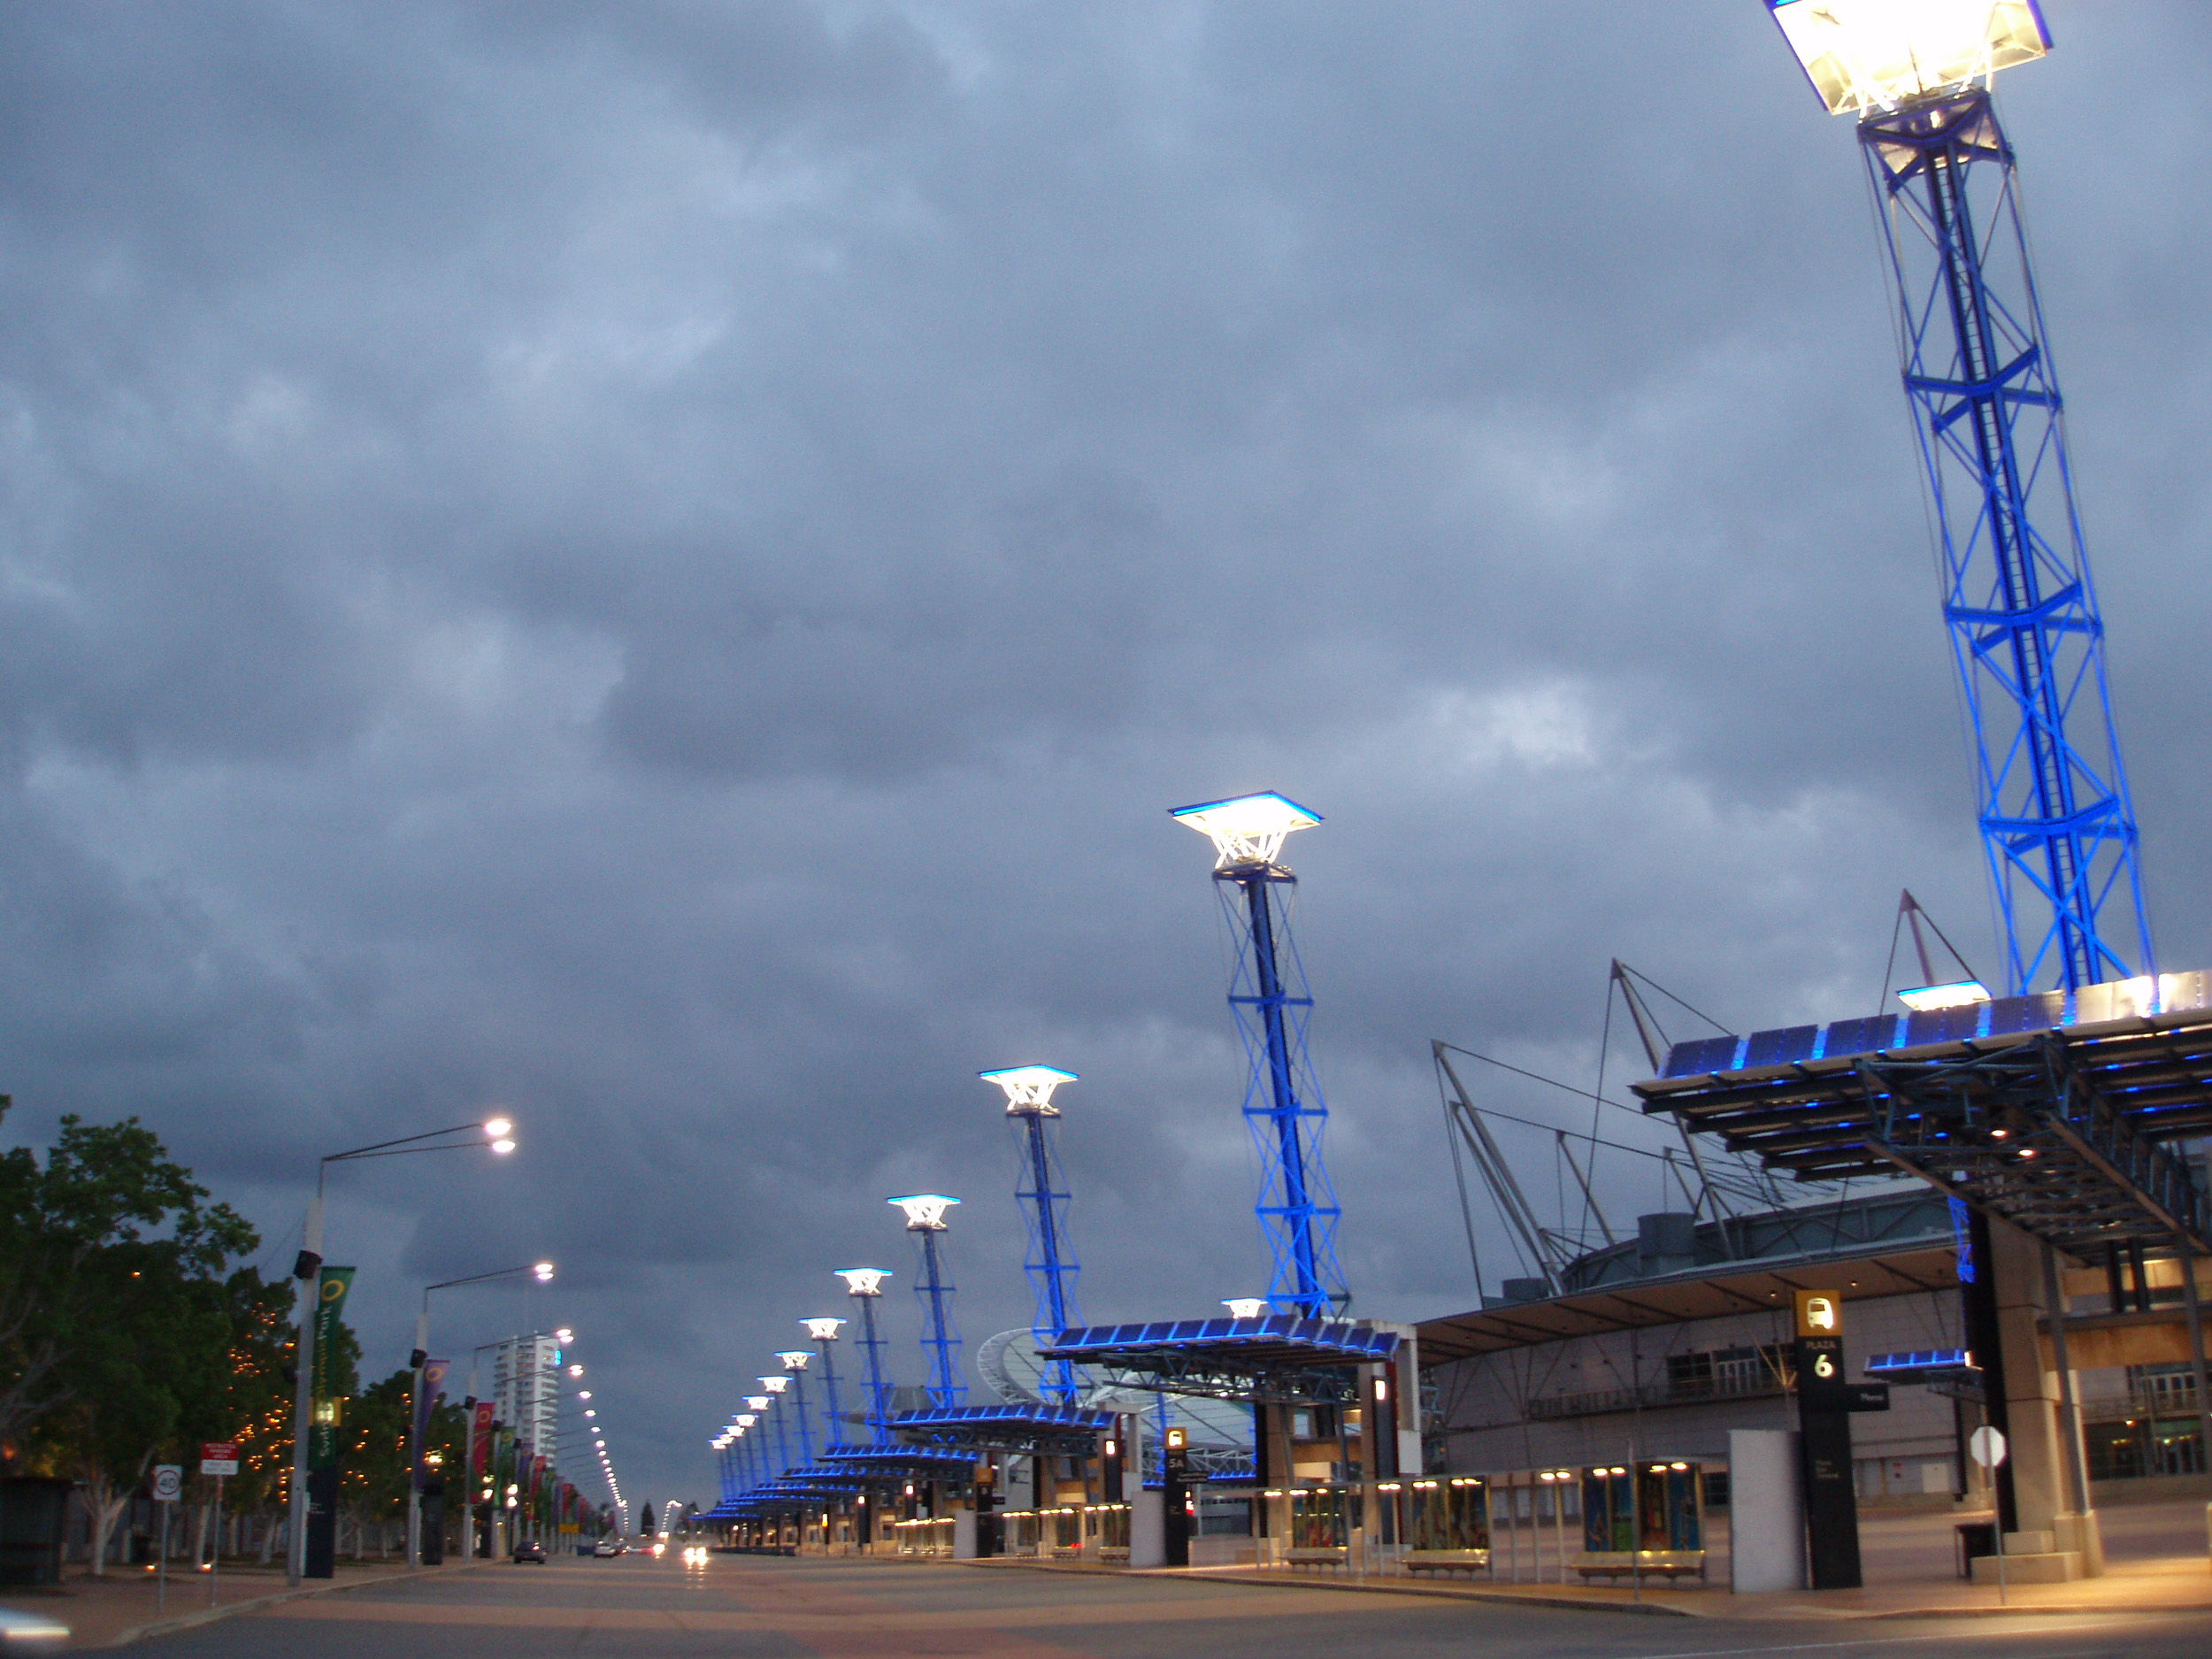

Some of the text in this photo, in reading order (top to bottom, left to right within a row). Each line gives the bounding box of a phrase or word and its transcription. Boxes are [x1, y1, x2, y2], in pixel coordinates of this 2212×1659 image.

[318, 1305, 333, 1340] Park
[1806, 1340, 1836, 1349] PLAZA
[1814, 1354, 1833, 1378] 6
[1168, 1458, 1184, 1468] 5A
[159, 1478, 177, 1489] 40
